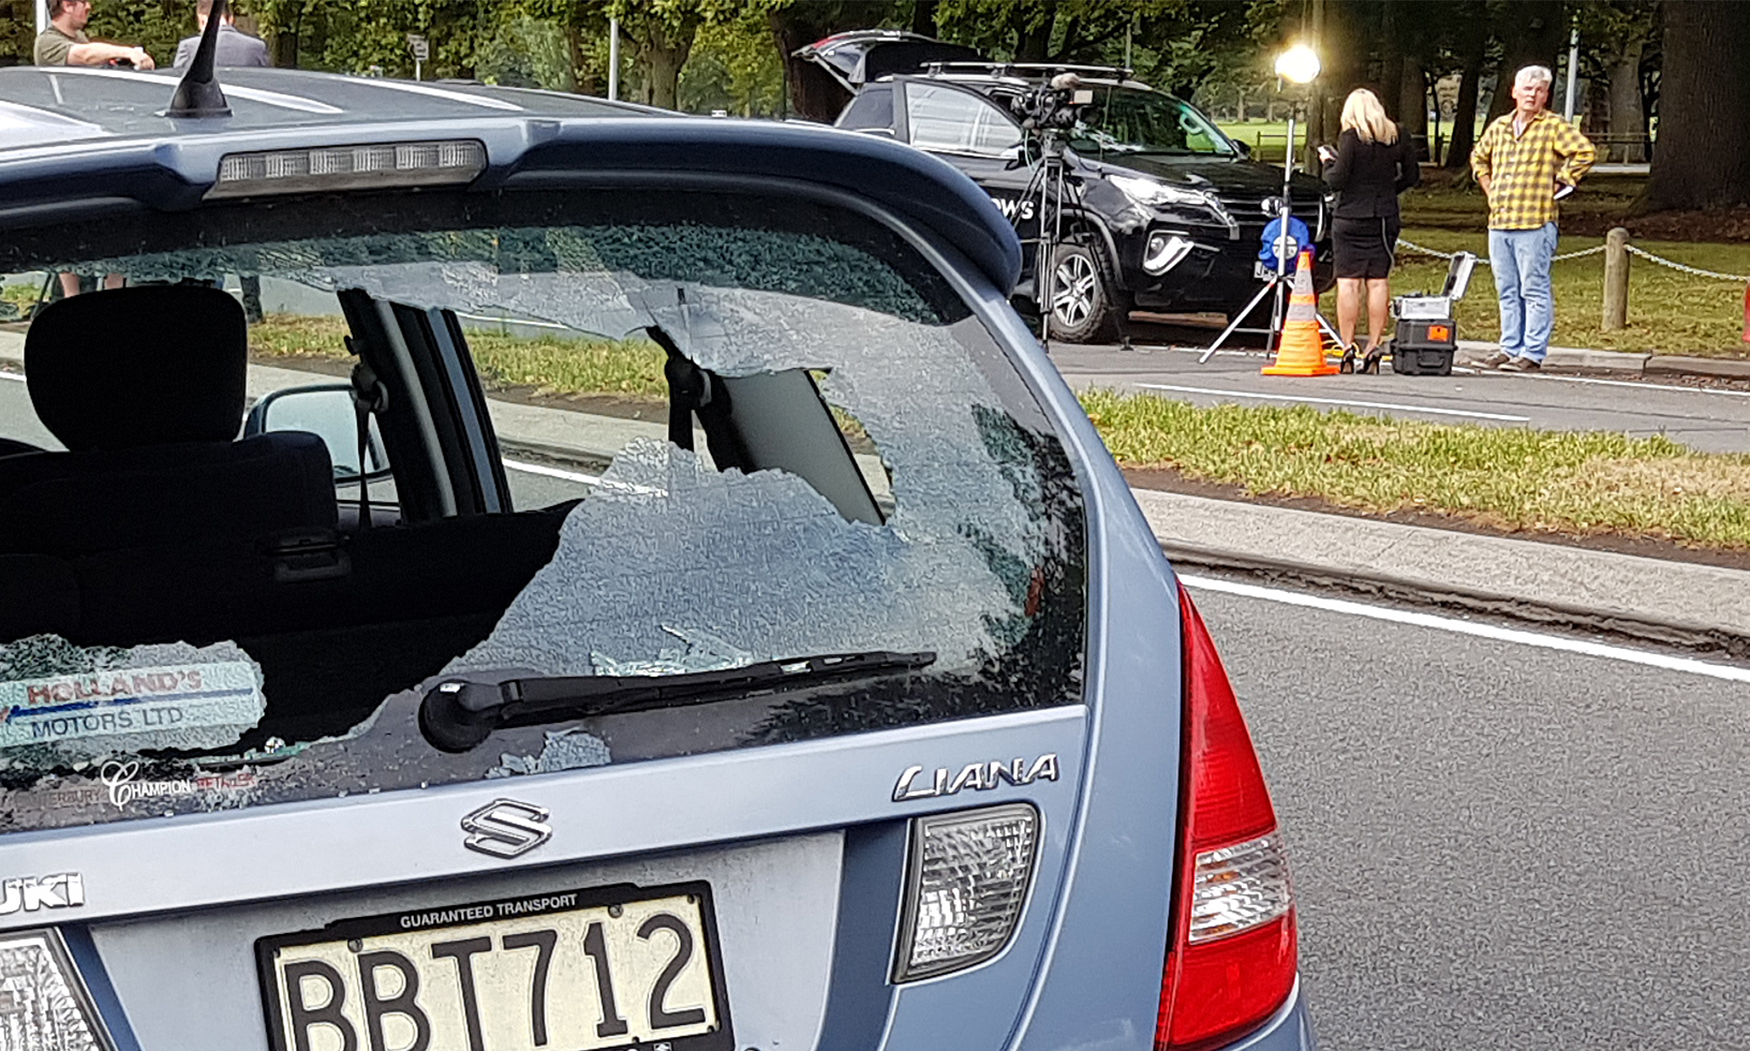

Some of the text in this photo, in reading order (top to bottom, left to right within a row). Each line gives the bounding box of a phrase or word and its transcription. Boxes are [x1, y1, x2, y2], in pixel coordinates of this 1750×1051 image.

[27, 671, 202, 704] HOLLAND'S
[32, 706, 183, 738] MOTORS LTD
[101, 761, 192, 812] CHAMPION
[891, 753, 1059, 802] LIANA
[400, 893, 577, 929] GUARANTEED TRANSPORT
